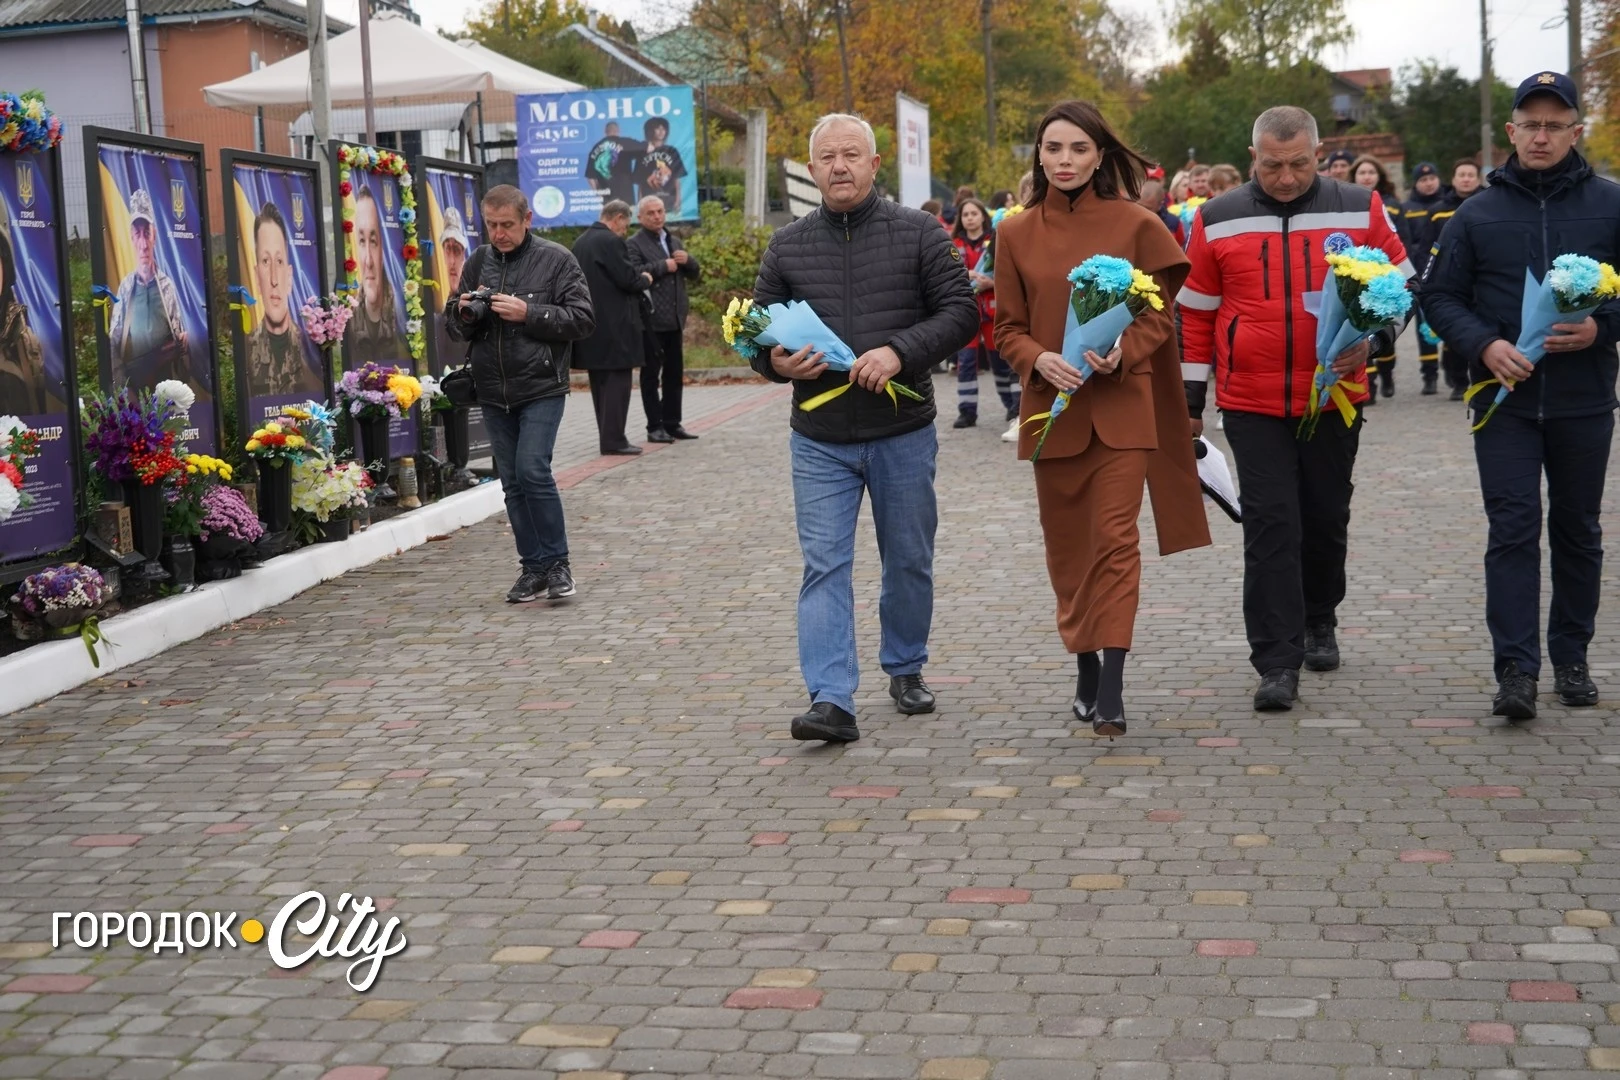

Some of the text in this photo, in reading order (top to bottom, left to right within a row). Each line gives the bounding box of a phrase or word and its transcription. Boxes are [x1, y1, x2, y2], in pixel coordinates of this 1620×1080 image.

[535, 126, 580, 142] style
[537, 158, 580, 168] ОДЯГУ та
[537, 167, 578, 177] БІЛИЗНИ
[264, 405, 281, 418] ГЕЛЬ
